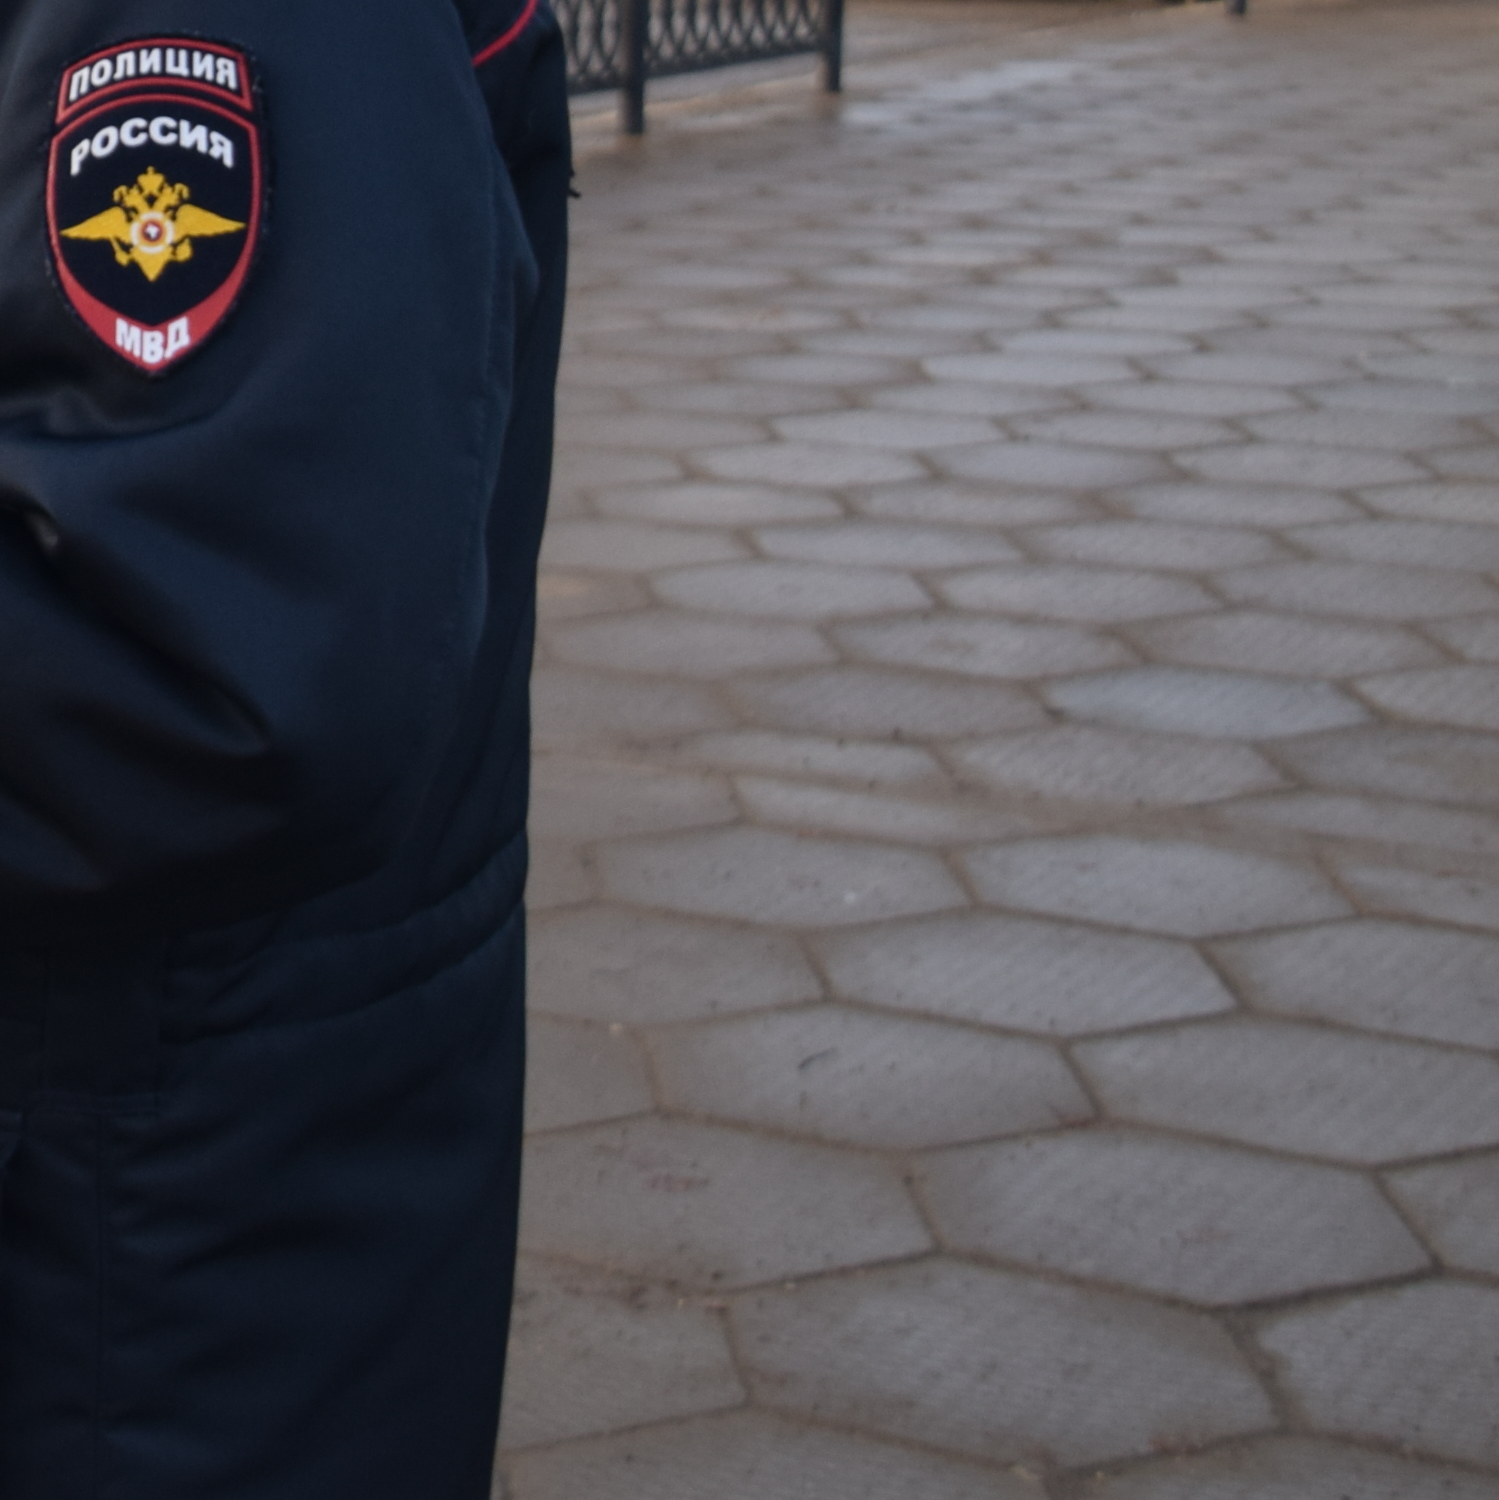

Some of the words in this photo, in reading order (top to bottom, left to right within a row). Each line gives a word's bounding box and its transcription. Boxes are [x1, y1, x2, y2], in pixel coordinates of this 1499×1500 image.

[69, 48, 238, 101] ПОЛИЦИЯ
[70, 116, 235, 176] РОССИЯ
[115, 316, 191, 364] МВД
